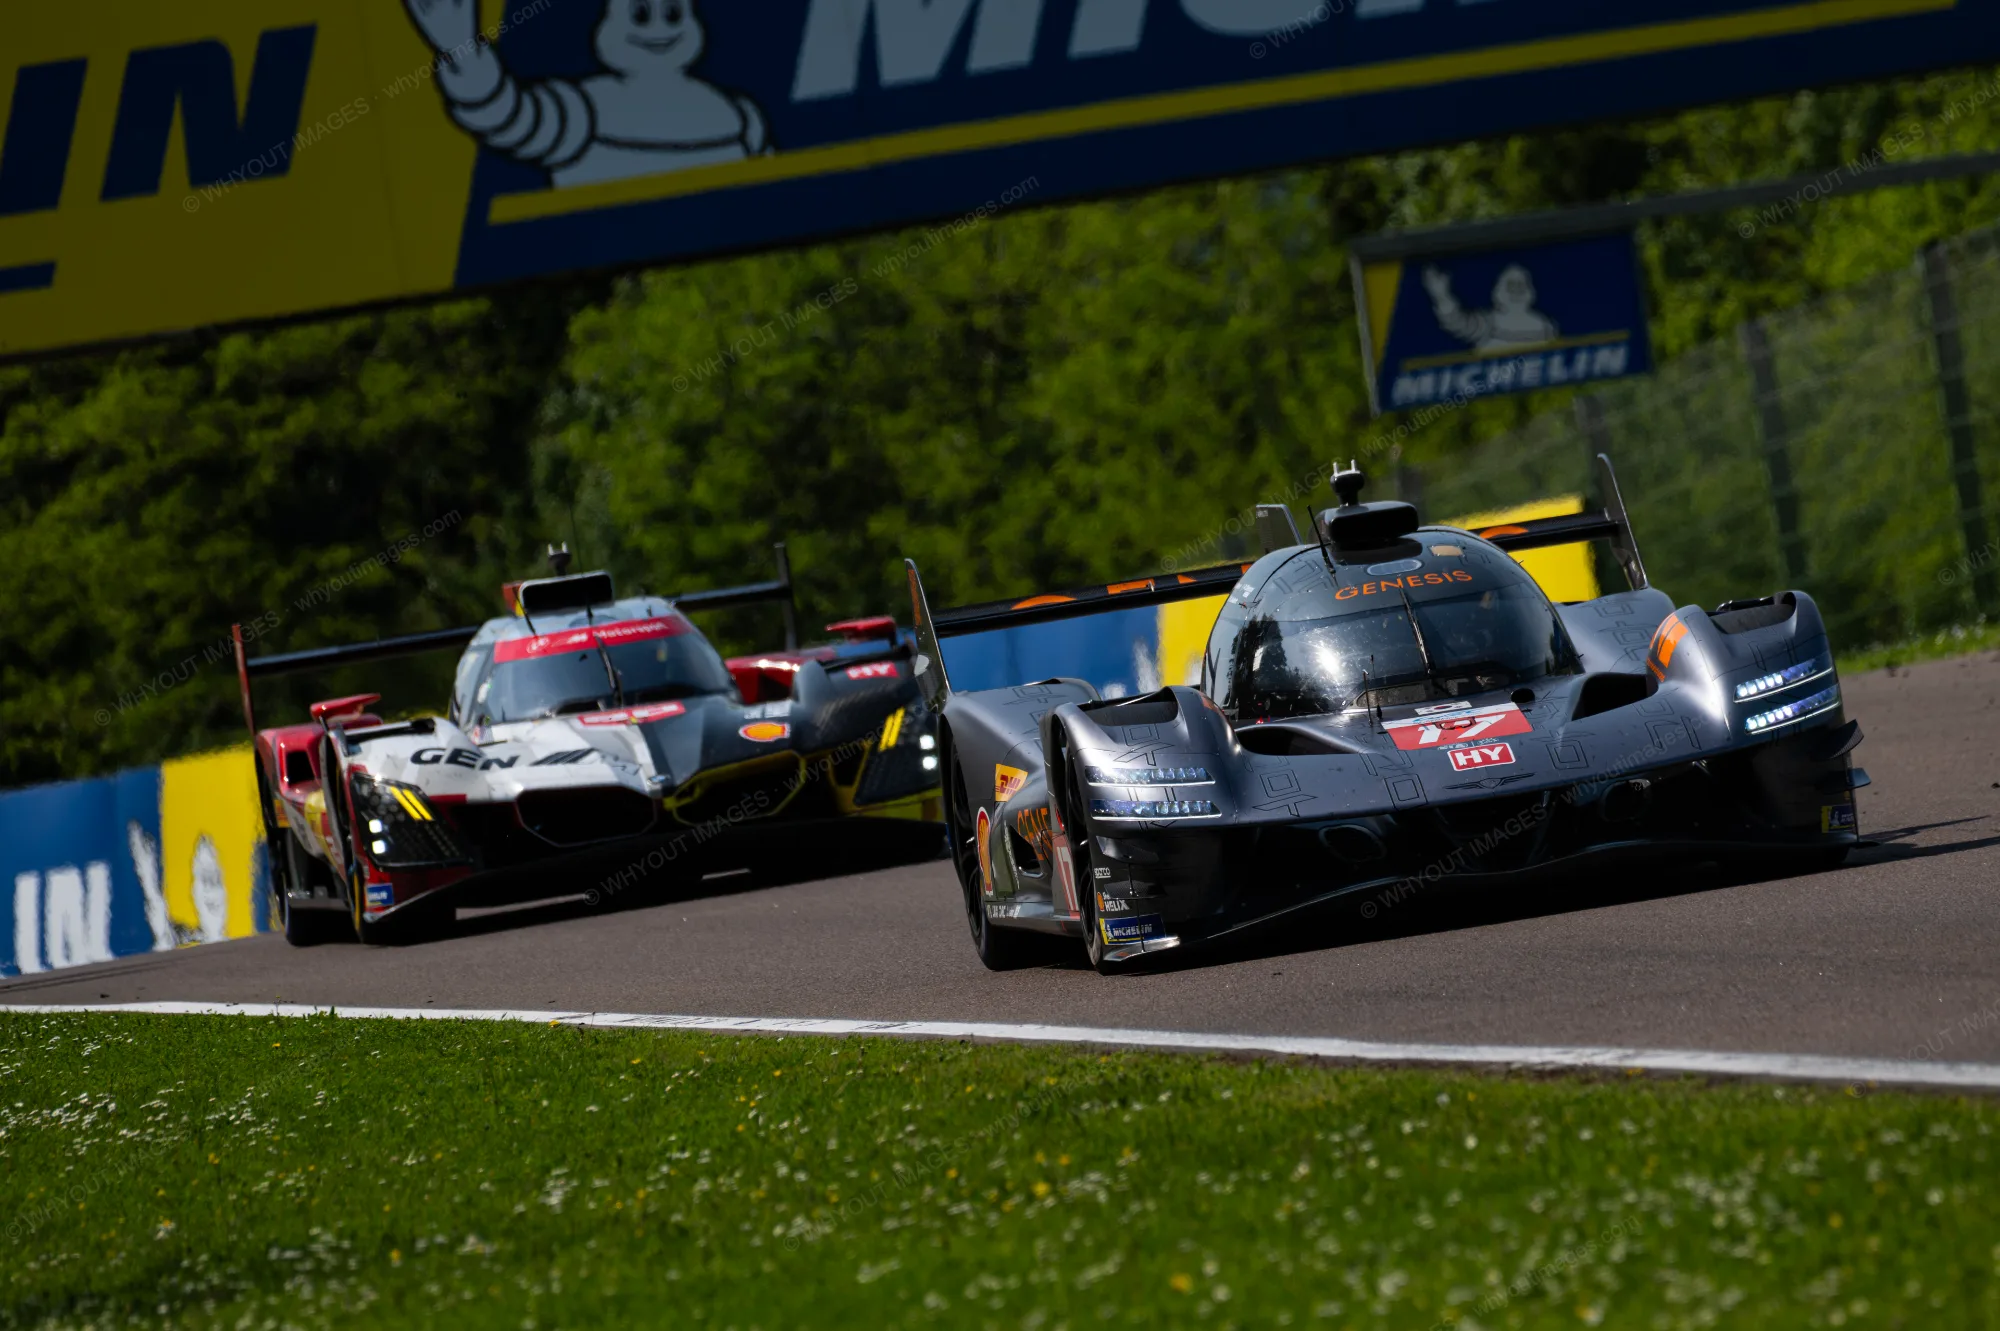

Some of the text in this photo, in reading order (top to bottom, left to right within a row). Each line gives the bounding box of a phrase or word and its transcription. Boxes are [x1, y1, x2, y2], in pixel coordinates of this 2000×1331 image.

[1391, 346, 1628, 406] MICHELIN
[1335, 570, 1473, 600] GENESIS
[1418, 714, 1507, 744] 17
[410, 748, 521, 771] GEN
[1455, 746, 1504, 766] HY
[1104, 900, 1130, 912] HELIX
[1112, 924, 1153, 937] MICHELIN
